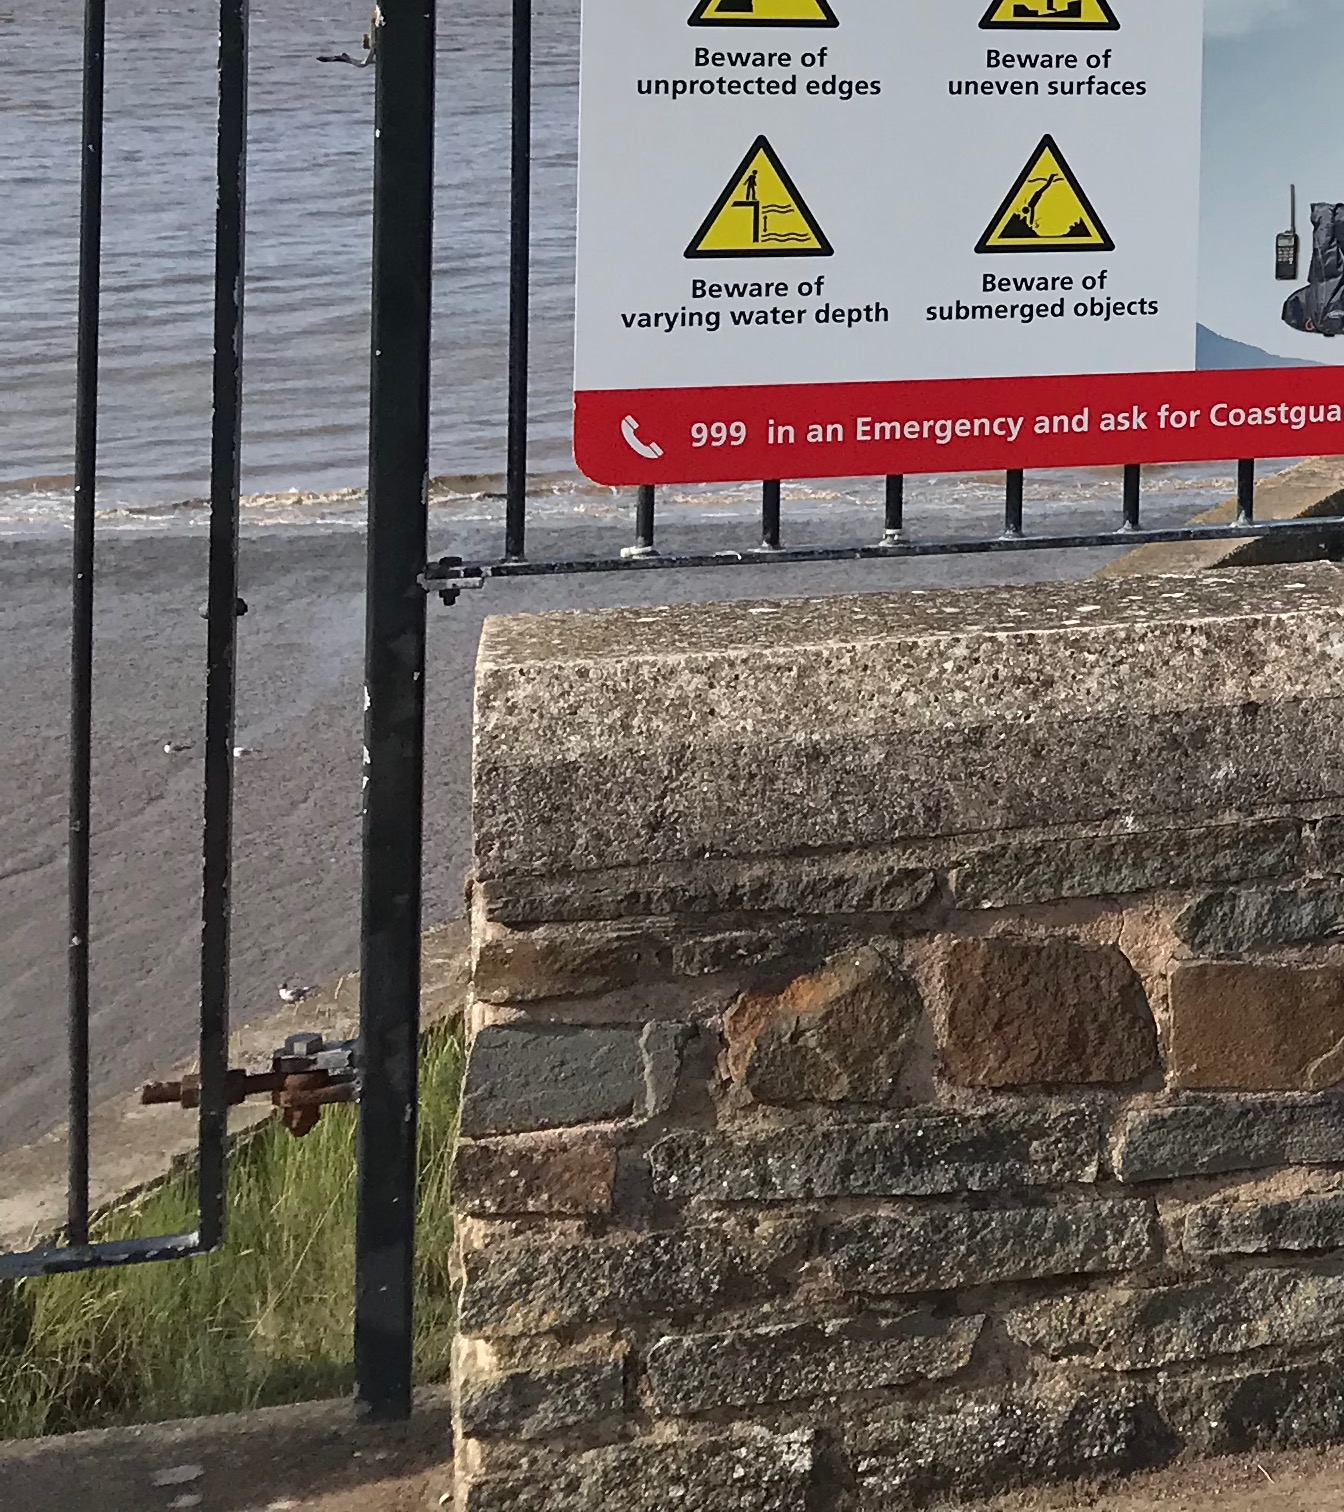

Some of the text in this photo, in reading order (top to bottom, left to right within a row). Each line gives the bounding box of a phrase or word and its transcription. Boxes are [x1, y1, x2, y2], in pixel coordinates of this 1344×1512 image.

[694, 46, 828, 68] Beware of
[986, 48, 1112, 70] Beware of
[637, 74, 882, 101] unprotected edges
[948, 75, 1148, 97] uneven surfaces
[691, 275, 825, 300] Beware of
[982, 270, 1108, 294] Beware of
[621, 301, 890, 333] varying water depth
[926, 296, 1159, 325] submerged objects
[690, 420, 748, 448] 999
[768, 419, 796, 445] in
[806, 422, 844, 444] an
[856, 414, 1024, 445] Emergency
[1033, 407, 1090, 435] and
[1100, 405, 1148, 432] ask
[1157, 403, 1201, 430] for
